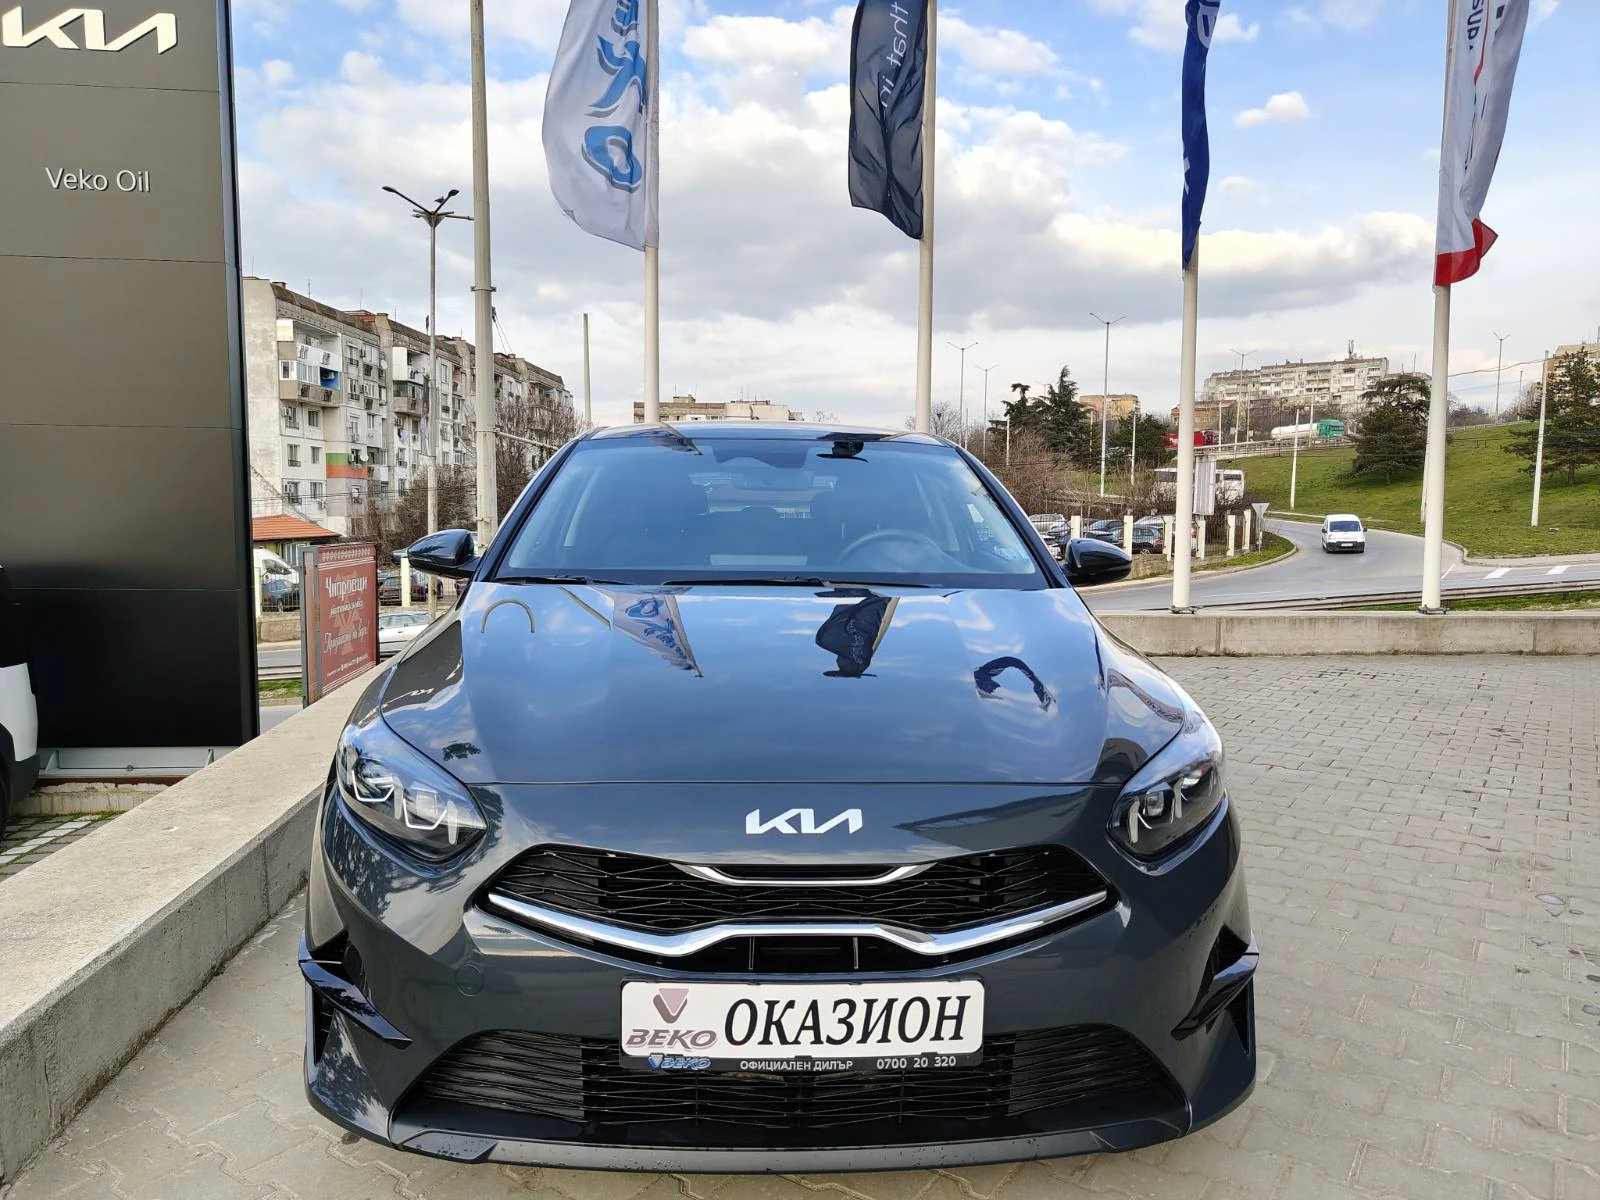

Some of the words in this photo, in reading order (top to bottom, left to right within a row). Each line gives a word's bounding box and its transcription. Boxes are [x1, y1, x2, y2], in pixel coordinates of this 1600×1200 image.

[1, 6, 177, 55] KIA
[45, 167, 108, 191] Veko
[116, 169, 151, 192] Oil
[745, 808, 863, 835] KIA
[724, 995, 972, 1047] ОКАЗИОН
[739, 1060, 811, 1071] ОФИЦИАЛЕН
[813, 1060, 854, 1072] ДИЛЪР
[876, 1058, 908, 1070] 0700
[913, 1057, 929, 1068] 20
[934, 1056, 957, 1067] 320
